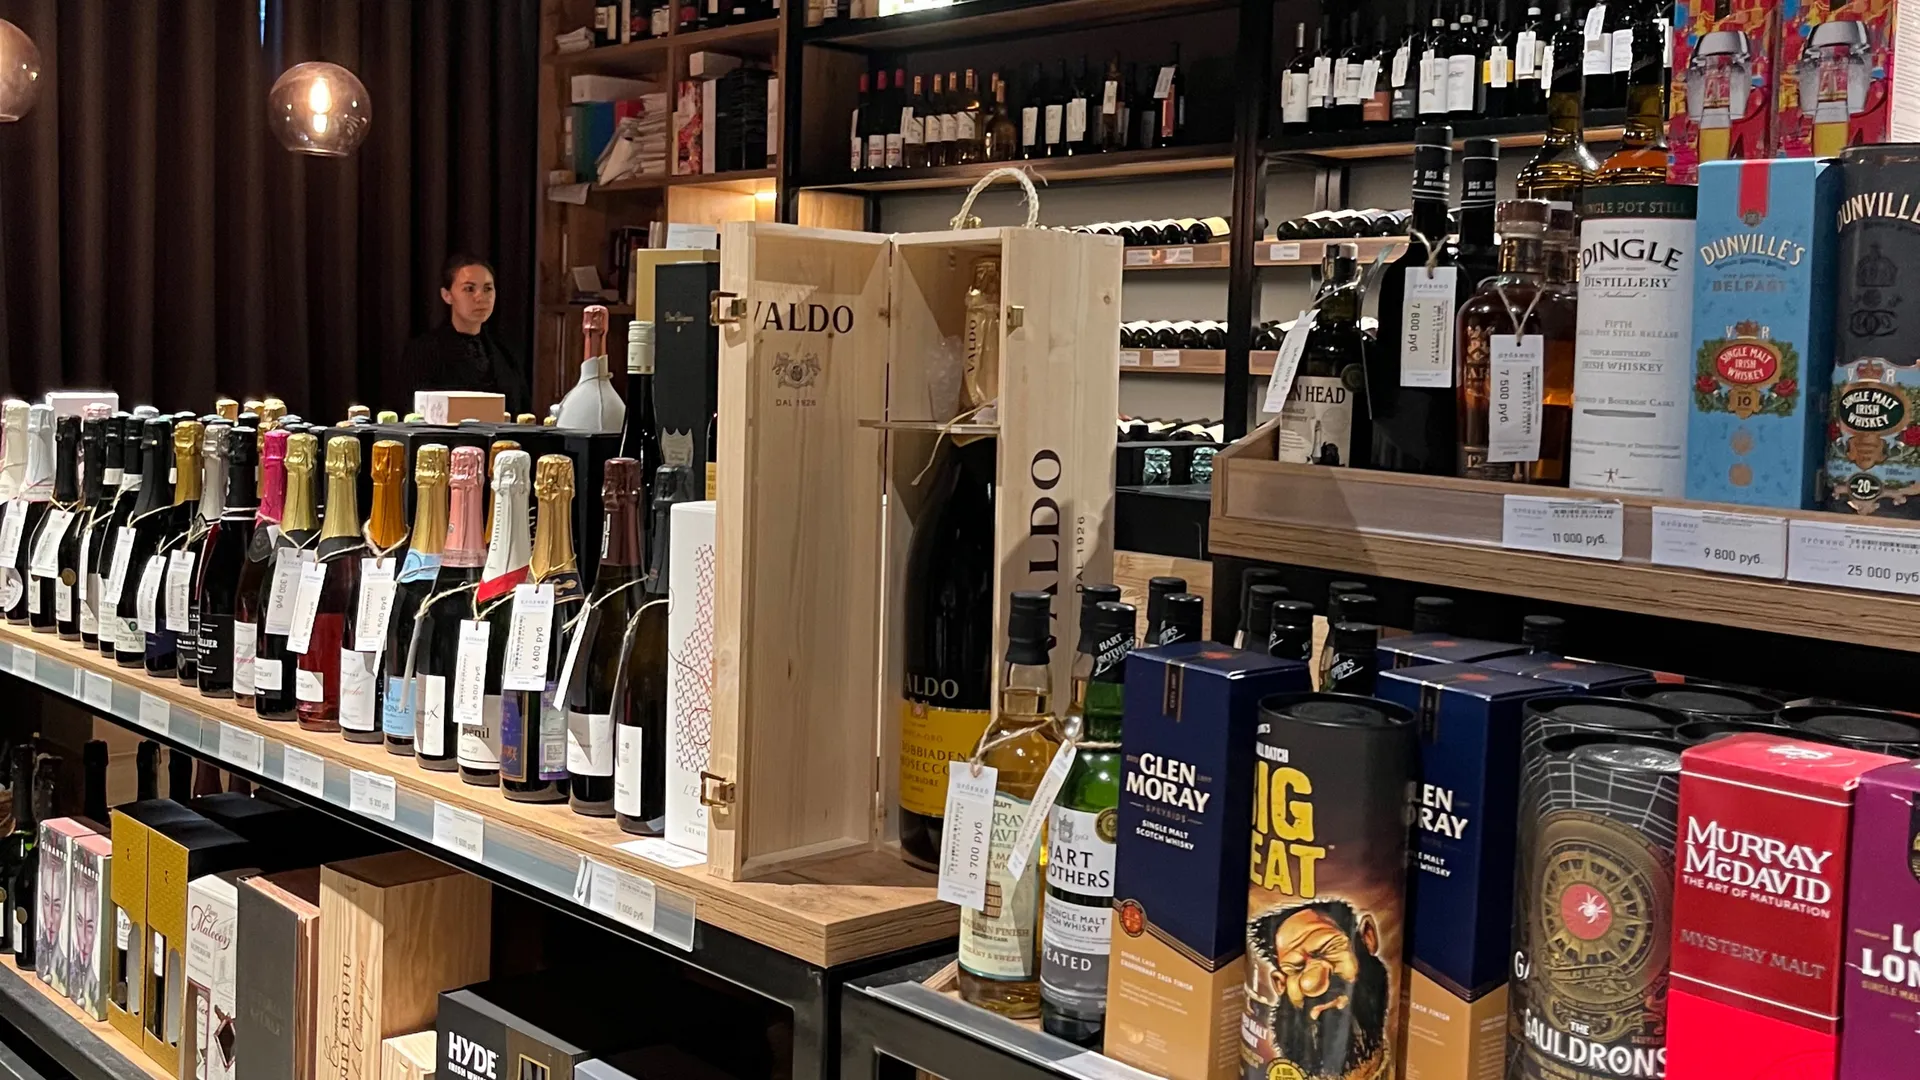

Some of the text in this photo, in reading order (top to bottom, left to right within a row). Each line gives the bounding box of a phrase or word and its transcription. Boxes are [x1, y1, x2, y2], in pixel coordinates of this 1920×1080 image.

[1617, 202, 1645, 213] POT
[1582, 238, 1684, 273] DINGLE
[1700, 233, 1806, 266] DUNVILLE'S
[1584, 276, 1672, 289] DISTILLERY
[1411, 311, 1421, 331] 800
[1720, 347, 1773, 364] SINGLE MALT
[1735, 358, 1757, 369] IRISH
[1607, 362, 1664, 373] WHISKEY
[1727, 366, 1765, 381] WHISKEY
[1306, 385, 1346, 405] HEAD
[1500, 380, 1510, 400] 500
[775, 399, 792, 407] DAL
[1842, 391, 1899, 411] SINGLE MALT
[1855, 404, 1880, 416] IRISH
[1847, 412, 1890, 429] WHISKEY
[1857, 479, 1871, 494] 20
[1076, 516, 1086, 553] 1926
[1563, 532, 1583, 544] 000
[1704, 547, 1711, 558] 9
[1714, 548, 1736, 562] 800
[1847, 564, 1863, 577] 25
[1867, 566, 1891, 580] 000
[1098, 632, 1123, 652] HART
[532, 645, 541, 662] 600
[1139, 753, 1197, 787] GLEN
[1125, 771, 1211, 814] MORAY
[1141, 819, 1189, 840] SINGLE MALT
[1135, 827, 1196, 851] SCOTCH WHISKY
[1684, 815, 1833, 875] MURRAY
[970, 846, 980, 868] 700
[969, 872, 978, 880] 3
[1682, 875, 1832, 919] THE ART OF MATURATION
[1064, 920, 1101, 933] WHISKY
[1080, 915, 1107, 926] MALT
[1680, 928, 1827, 980] MYSTERY MALT
[341, 954, 352, 1030] BOUJU
[1569, 1021, 1590, 1036] THE
[448, 1031, 498, 1080] HYDE
